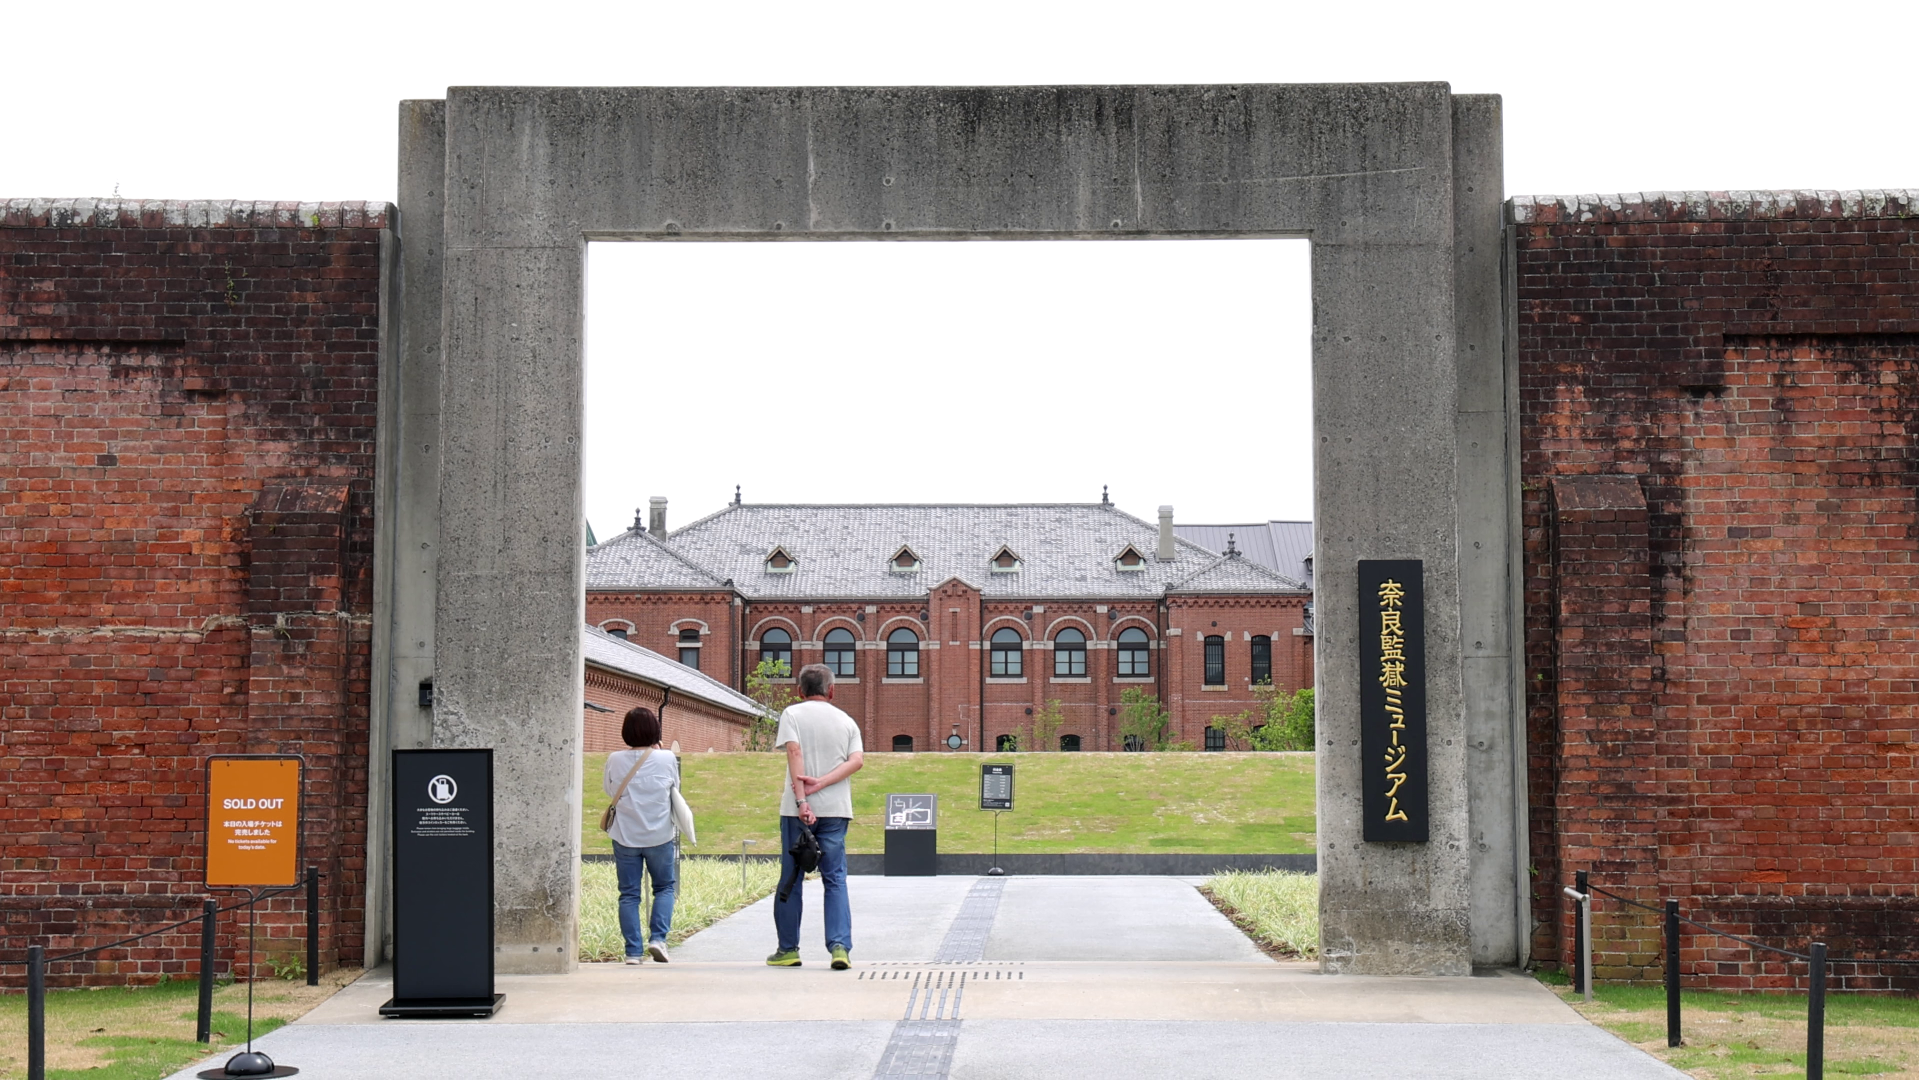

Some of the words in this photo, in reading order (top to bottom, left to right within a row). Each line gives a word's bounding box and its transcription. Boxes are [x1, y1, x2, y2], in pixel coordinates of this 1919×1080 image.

[1377, 578, 1409, 821] 奈良監獄ミュージアム
[223, 798, 256, 809] SOLD
[258, 798, 284, 809] OUT
[223, 820, 283, 828] 本日の入場チケットは
